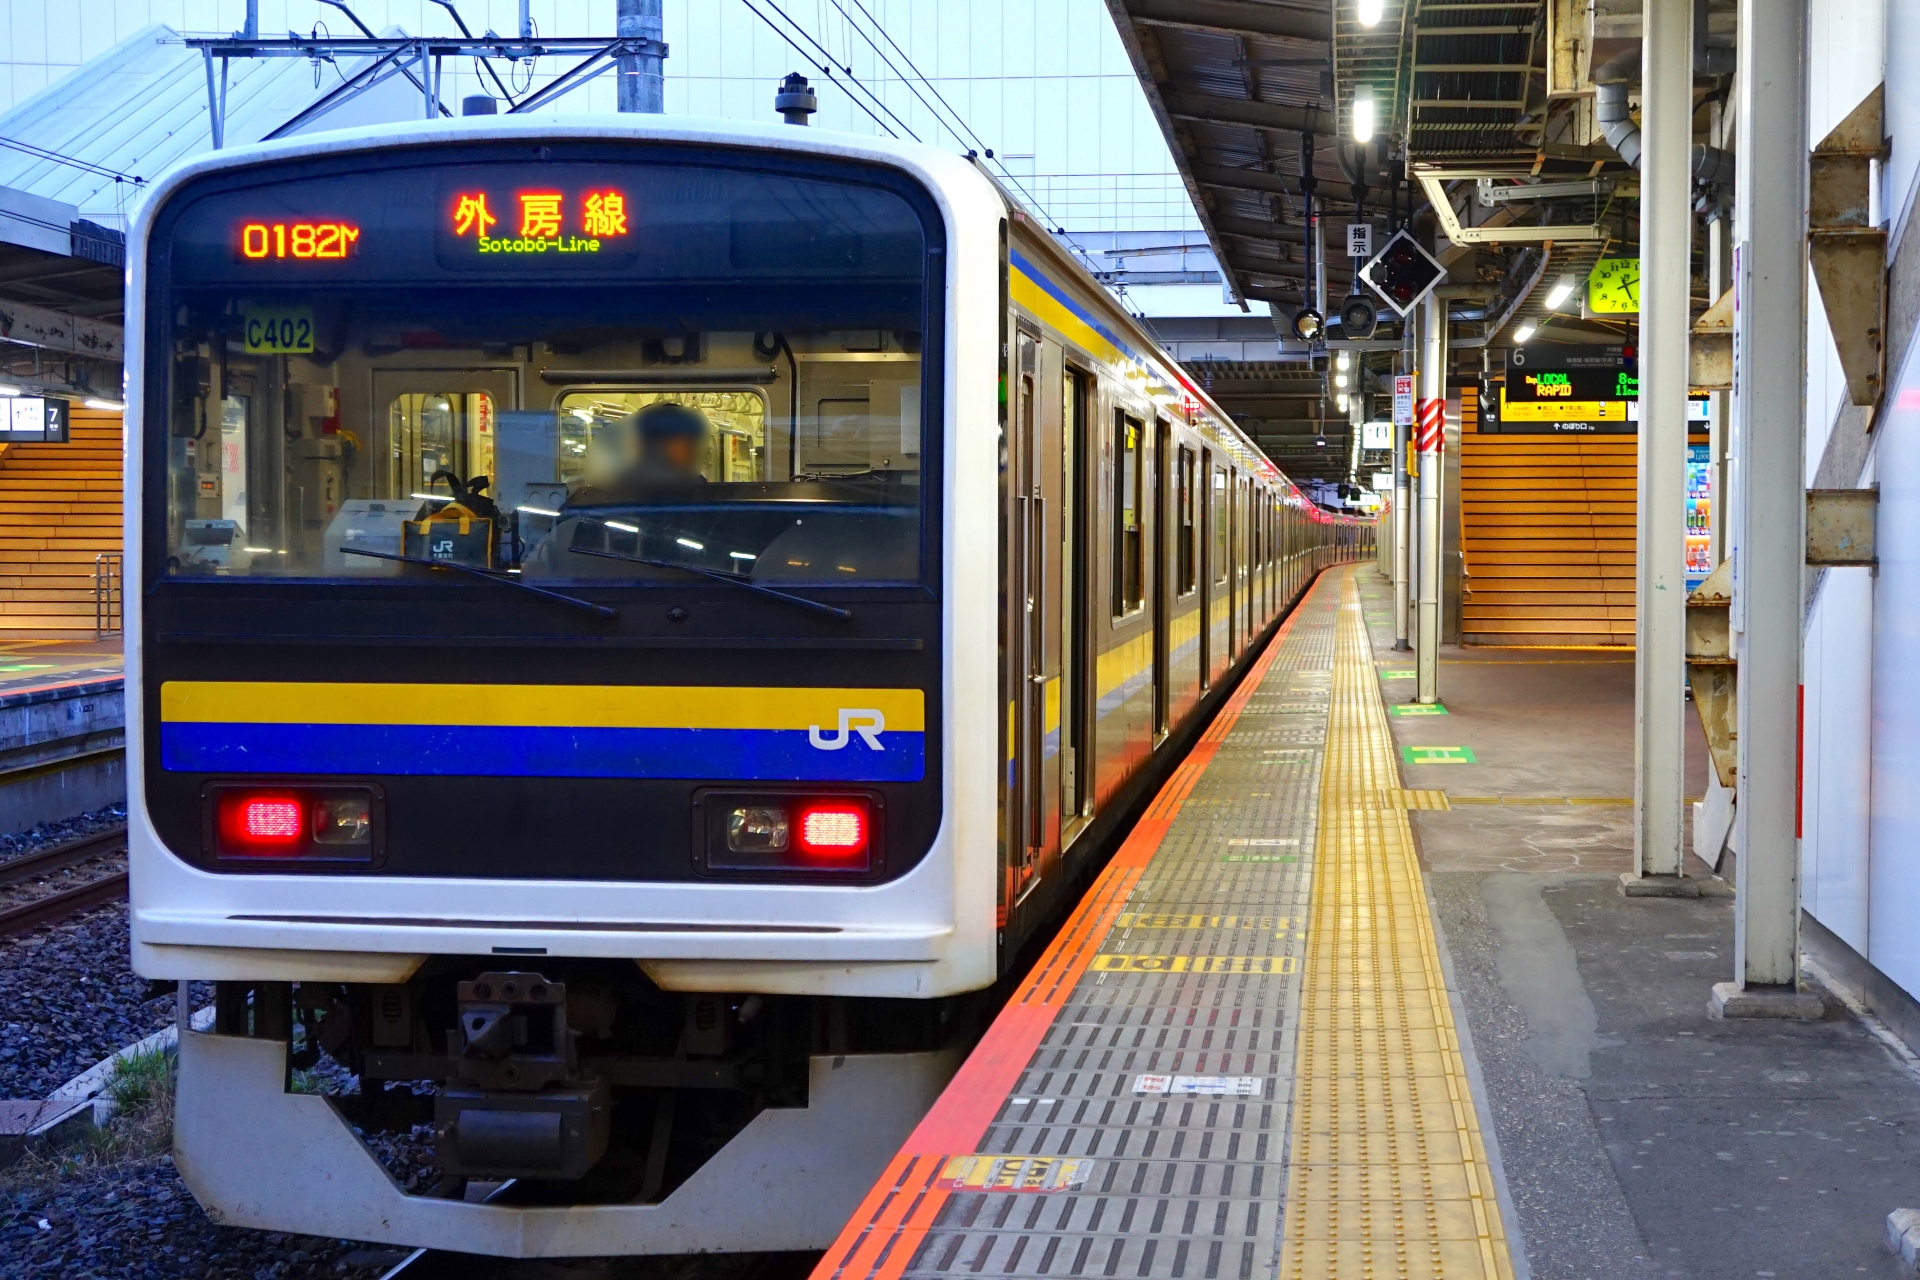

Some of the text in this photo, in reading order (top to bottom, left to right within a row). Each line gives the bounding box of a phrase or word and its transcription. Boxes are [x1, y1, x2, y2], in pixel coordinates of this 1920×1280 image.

[454, 192, 627, 237] 外房線
[1352, 227, 1366, 254] 指示
[1611, 263, 1619, 271] 11
[247, 318, 311, 349] C402
[1512, 347, 1525, 366] 6
[1537, 373, 1571, 385] LOCAL
[1618, 372, 1627, 385] 8
[1537, 384, 1572, 396] RAPID
[1616, 384, 1627, 396] 11
[48, 408, 58, 423] 7
[1561, 422, 1588, 431] のぼり口
[432, 540, 454, 553] JR
[808, 708, 885, 751] JR
